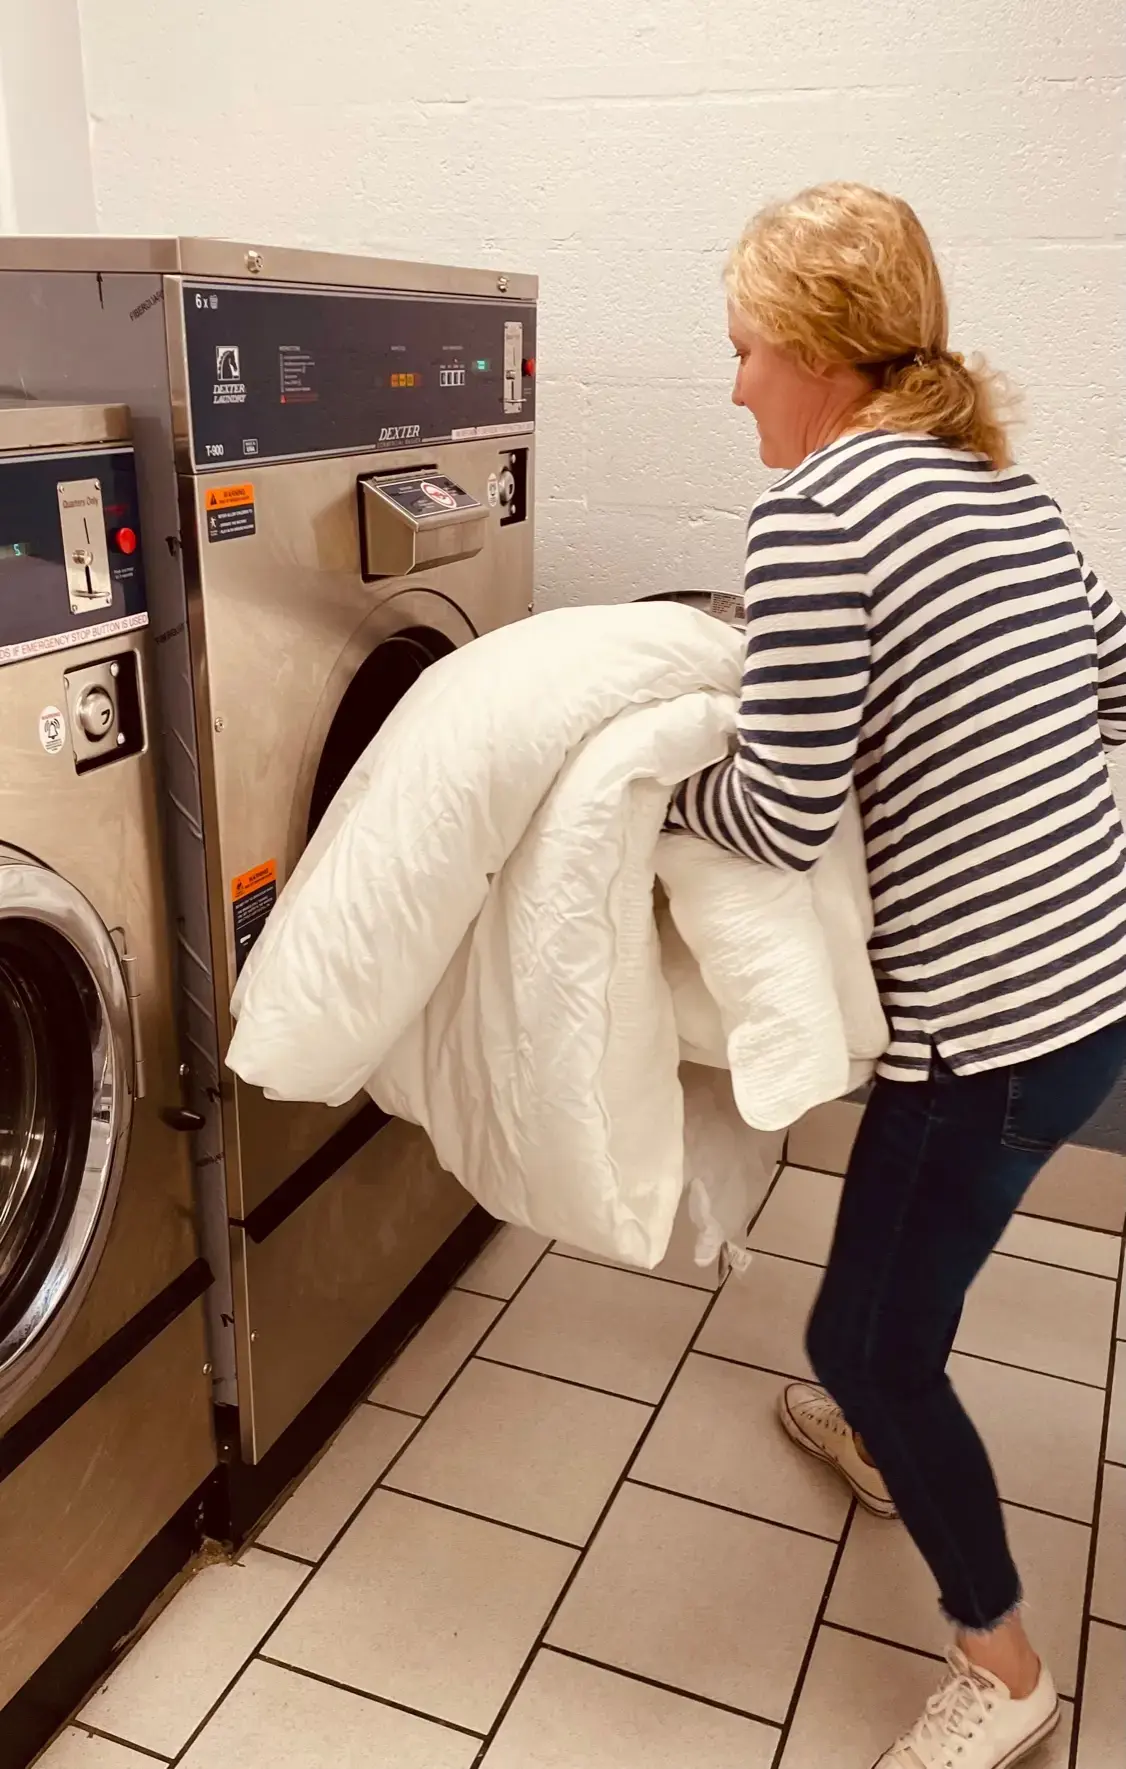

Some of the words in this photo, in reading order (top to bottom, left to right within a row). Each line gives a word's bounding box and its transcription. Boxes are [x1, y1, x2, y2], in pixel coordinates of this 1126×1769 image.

[195, 293, 202, 309] 6
[203, 298, 209, 309] x
[213, 383, 246, 394] DEXTER
[213, 394, 247, 404] LAUNDRY
[378, 424, 420, 441] DEXTER
[205, 444, 224, 457] T-900
[62, 499, 85, 509] Quarters
[86, 496, 98, 507] Only
[12, 645, 20, 657] IF
[21, 634, 69, 655] EMERGENCY
[71, 629, 92, 643] STOP
[92, 621, 121, 637] BUTTON
[121, 619, 129, 630] IS
[129, 613, 148, 627] USED
